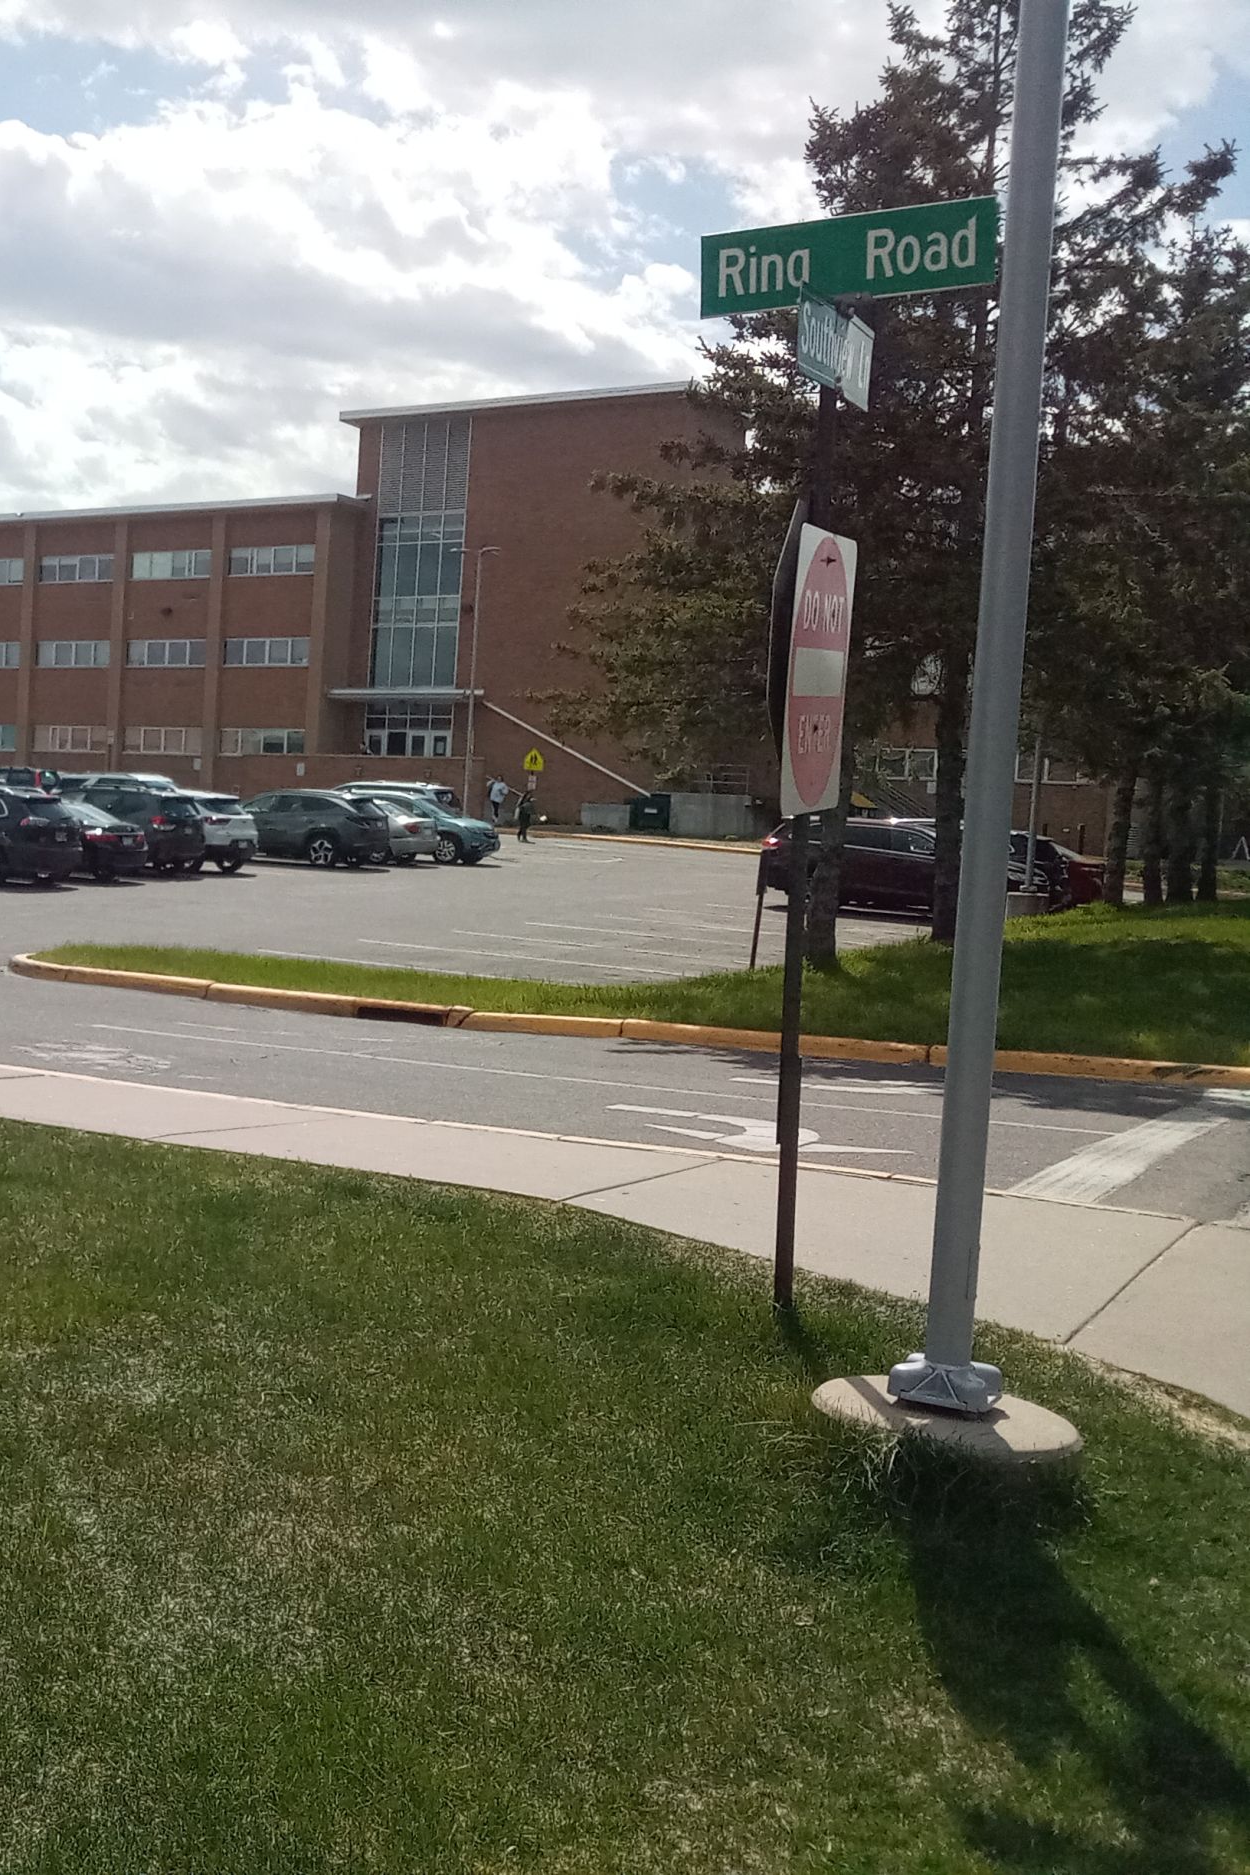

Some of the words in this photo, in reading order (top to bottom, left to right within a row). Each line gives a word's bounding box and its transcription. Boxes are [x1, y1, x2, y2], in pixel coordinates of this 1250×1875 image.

[718, 247, 811, 298] Ring
[866, 214, 978, 280] Road
[803, 590, 820, 631] DO
[823, 594, 845, 634] NOT
[797, 713, 831, 754] ENTER
